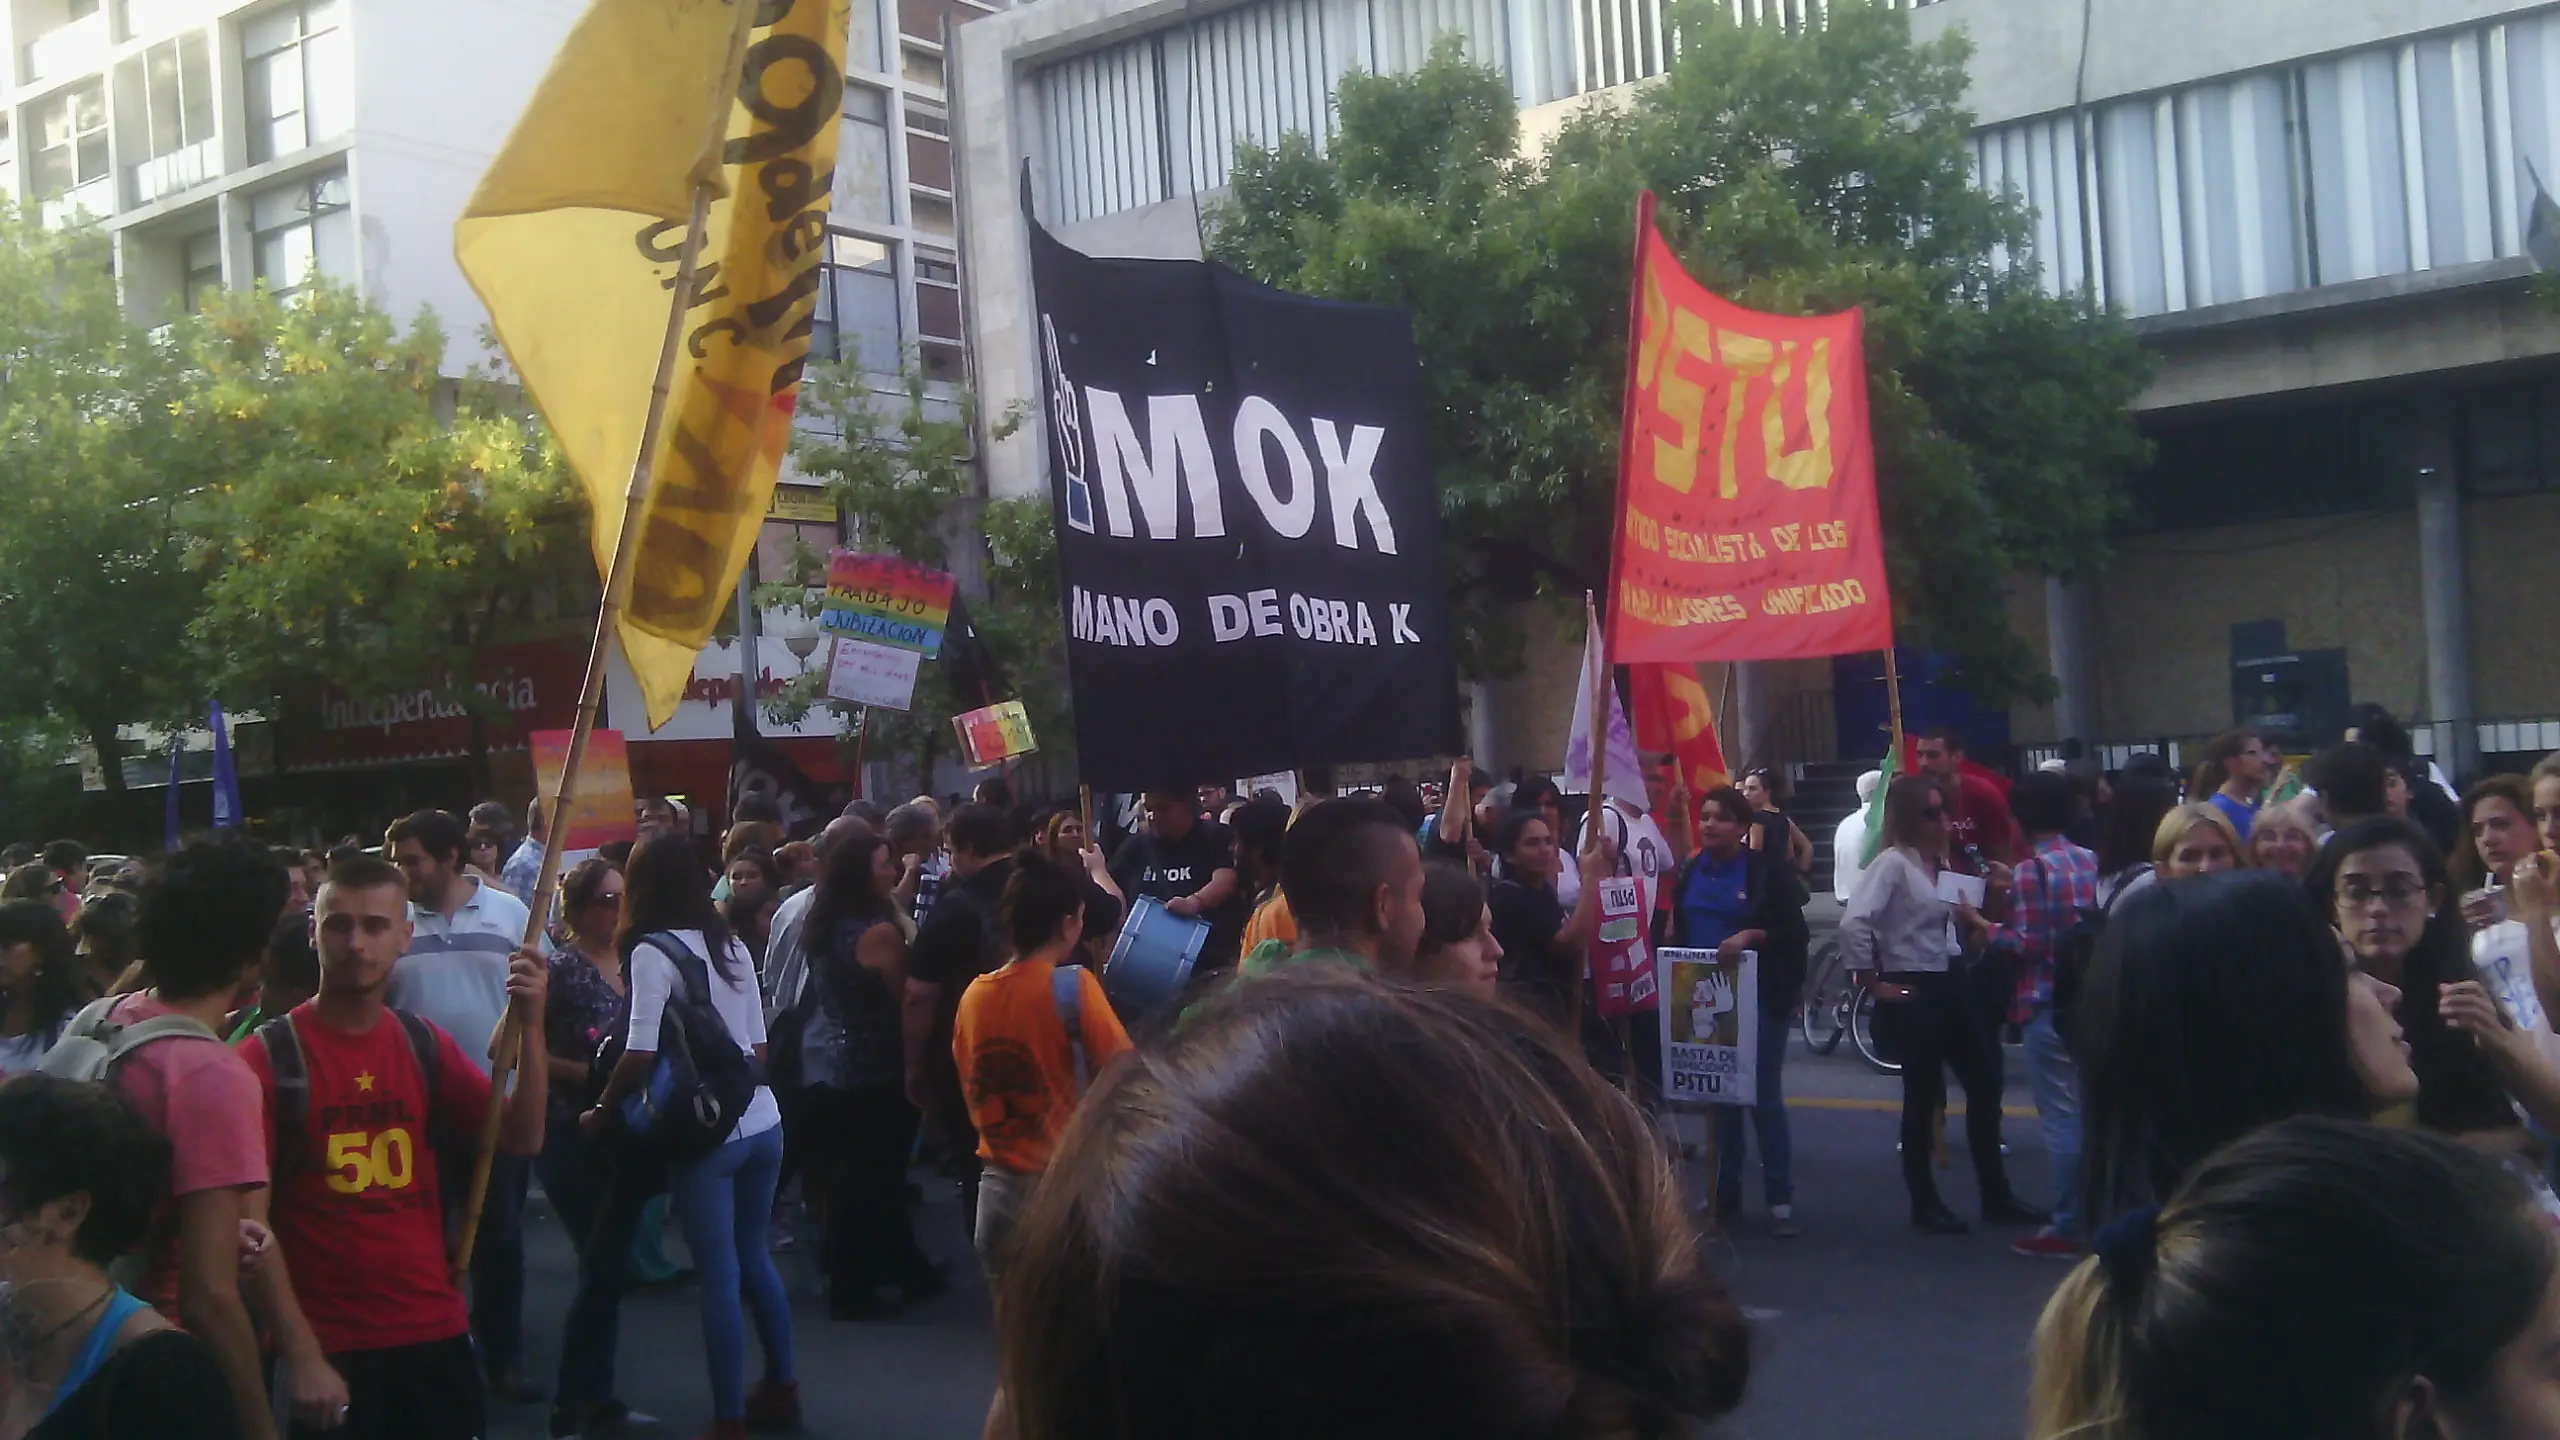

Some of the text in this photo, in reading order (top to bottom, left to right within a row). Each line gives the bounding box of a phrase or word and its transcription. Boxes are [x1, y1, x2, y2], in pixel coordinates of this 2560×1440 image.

[1085, 386, 1397, 555] MOK
[1664, 526, 1766, 563] SOCIALISTA
[1770, 522, 1800, 552] DE
[1808, 520, 1847, 552] LOS
[829, 583, 925, 615] TRABAJO
[1072, 585, 1420, 647] MANO DE OBRA K
[1762, 578, 1867, 616] UNIFICADO
[1610, 887, 1636, 909] PSTU
[1671, 1046, 1717, 1062] BASTA
[1673, 1070, 1721, 1094] PSTU
[325, 1127, 413, 1194] 50
